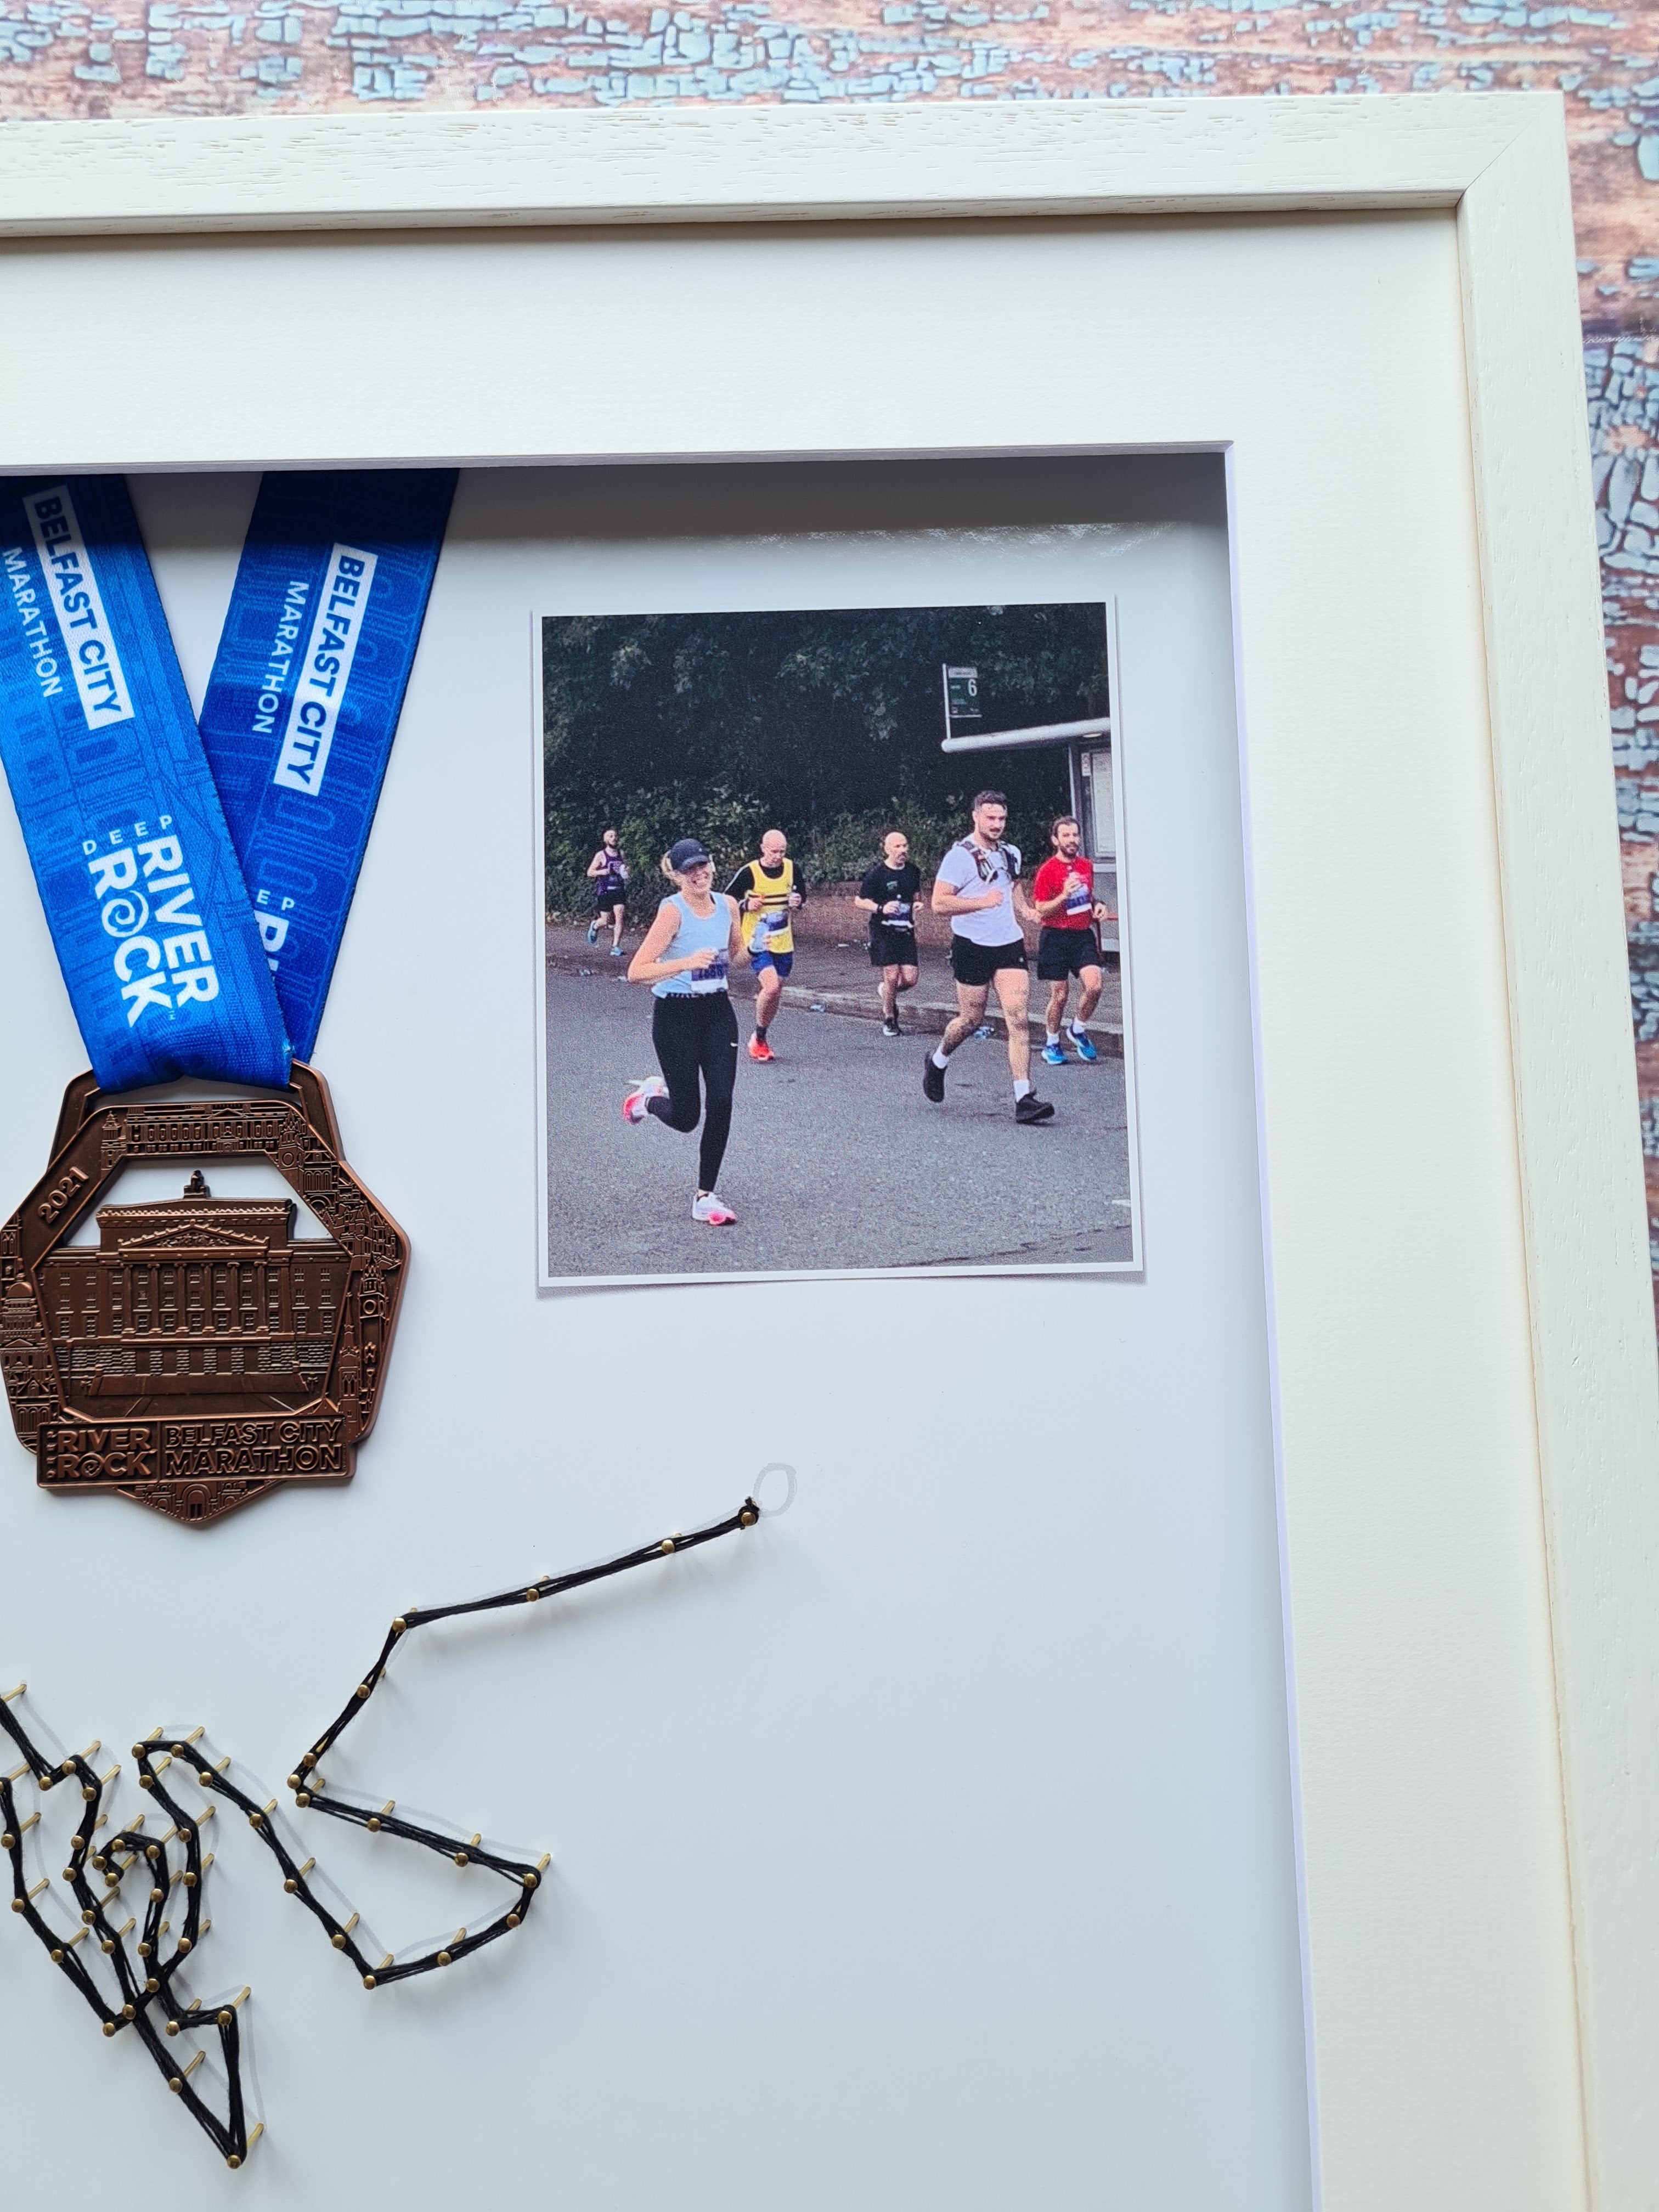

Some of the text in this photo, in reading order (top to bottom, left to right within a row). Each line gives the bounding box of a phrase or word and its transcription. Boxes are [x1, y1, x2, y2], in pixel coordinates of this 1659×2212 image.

[3, 546, 63, 697] MARATHON
[34, 496, 122, 712] BELFAST CITY
[252, 580, 309, 734] MARATHON
[286, 555, 365, 785] BELFAST CITY
[967, 678, 978, 697] 6
[82, 814, 173, 856] DEEP
[137, 834, 220, 1008] RIVER
[256, 889, 295, 911] EP
[88, 847, 173, 1029] ROCK
[37, 1166, 89, 1224] 2021
[57, 1427, 152, 1453] RIVER
[165, 1421, 275, 1448] BELFAST
[279, 1419, 342, 1443] CITY
[57, 1451, 152, 1479] ROCK
[165, 1443, 342, 1476] MARATHON
